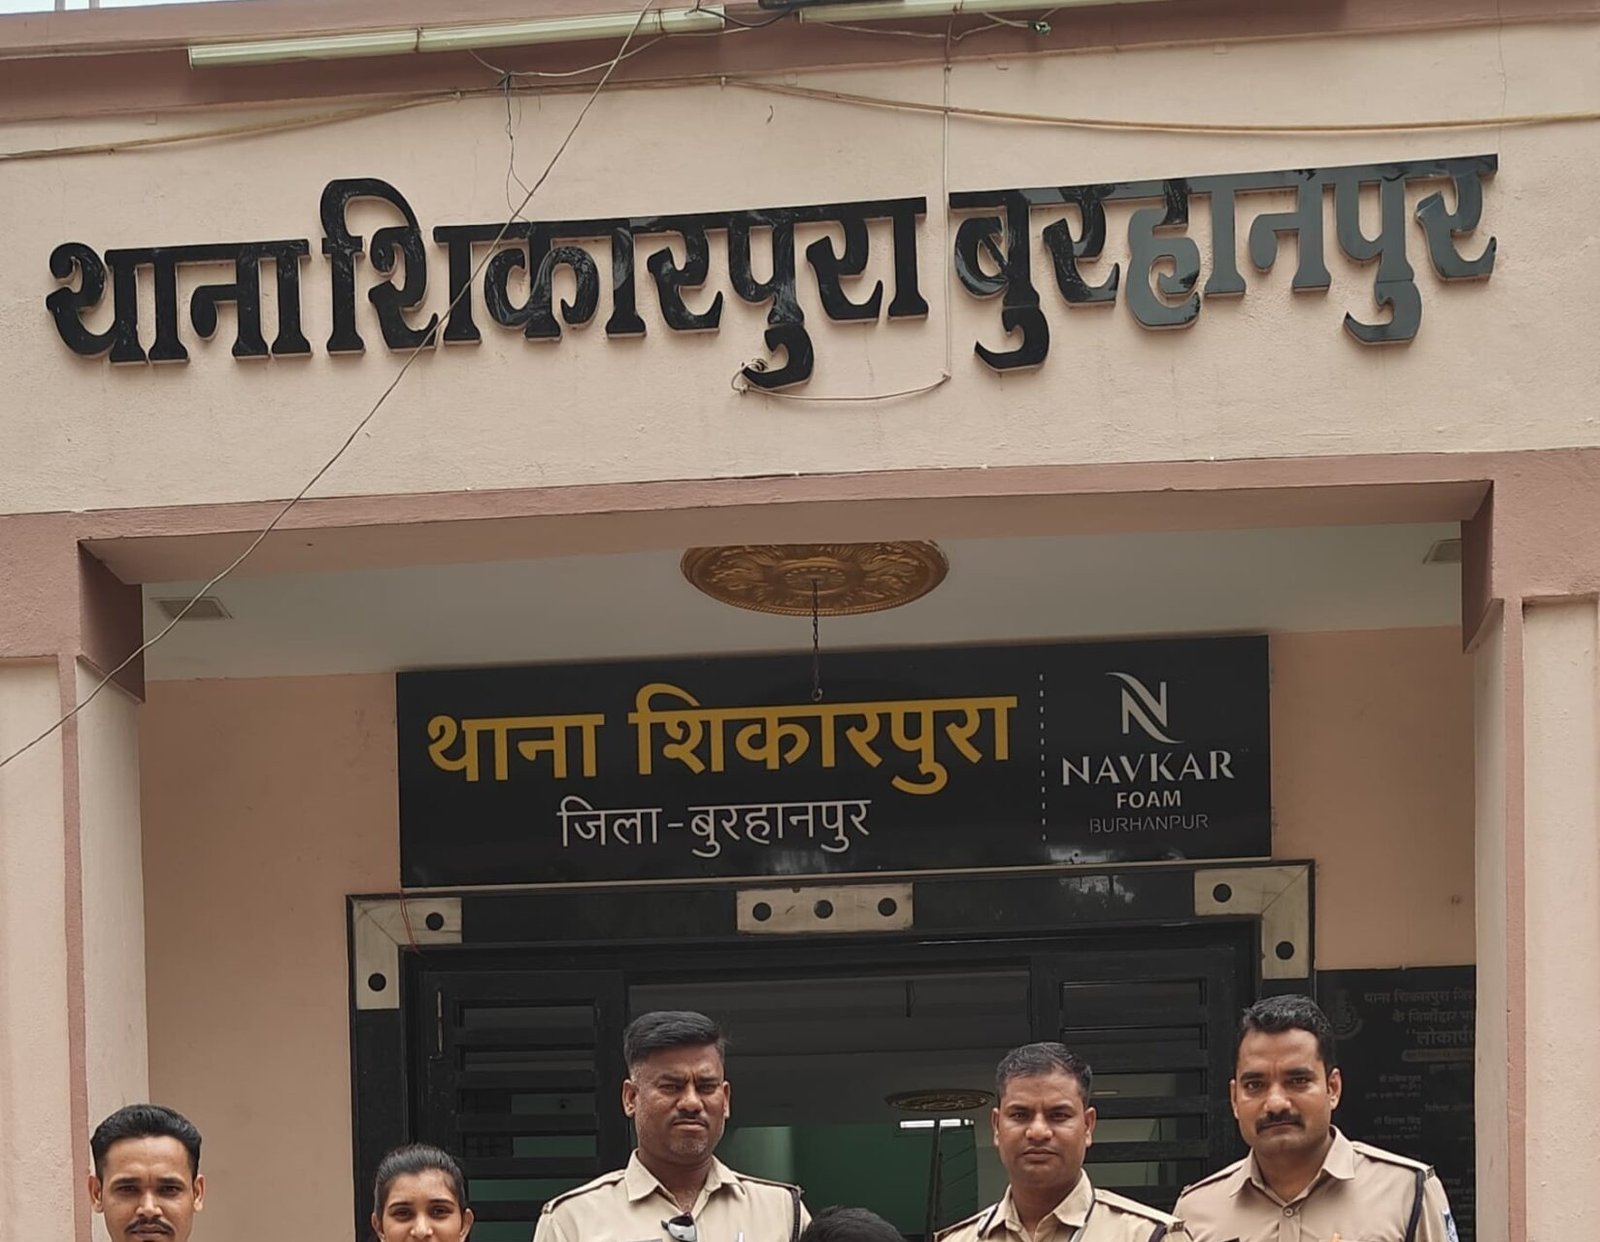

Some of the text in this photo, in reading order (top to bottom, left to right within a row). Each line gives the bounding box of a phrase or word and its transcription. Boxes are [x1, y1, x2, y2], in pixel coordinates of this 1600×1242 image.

[46, 153, 1499, 390] थाना शिकारपुरा बुरहानपुर
[427, 684, 1018, 795] थाना शिकारपुरा
[1062, 751, 1236, 786] NAVKAR
[1116, 790, 1182, 809] FOAM
[1089, 814, 1209, 834] BURHANPUR
